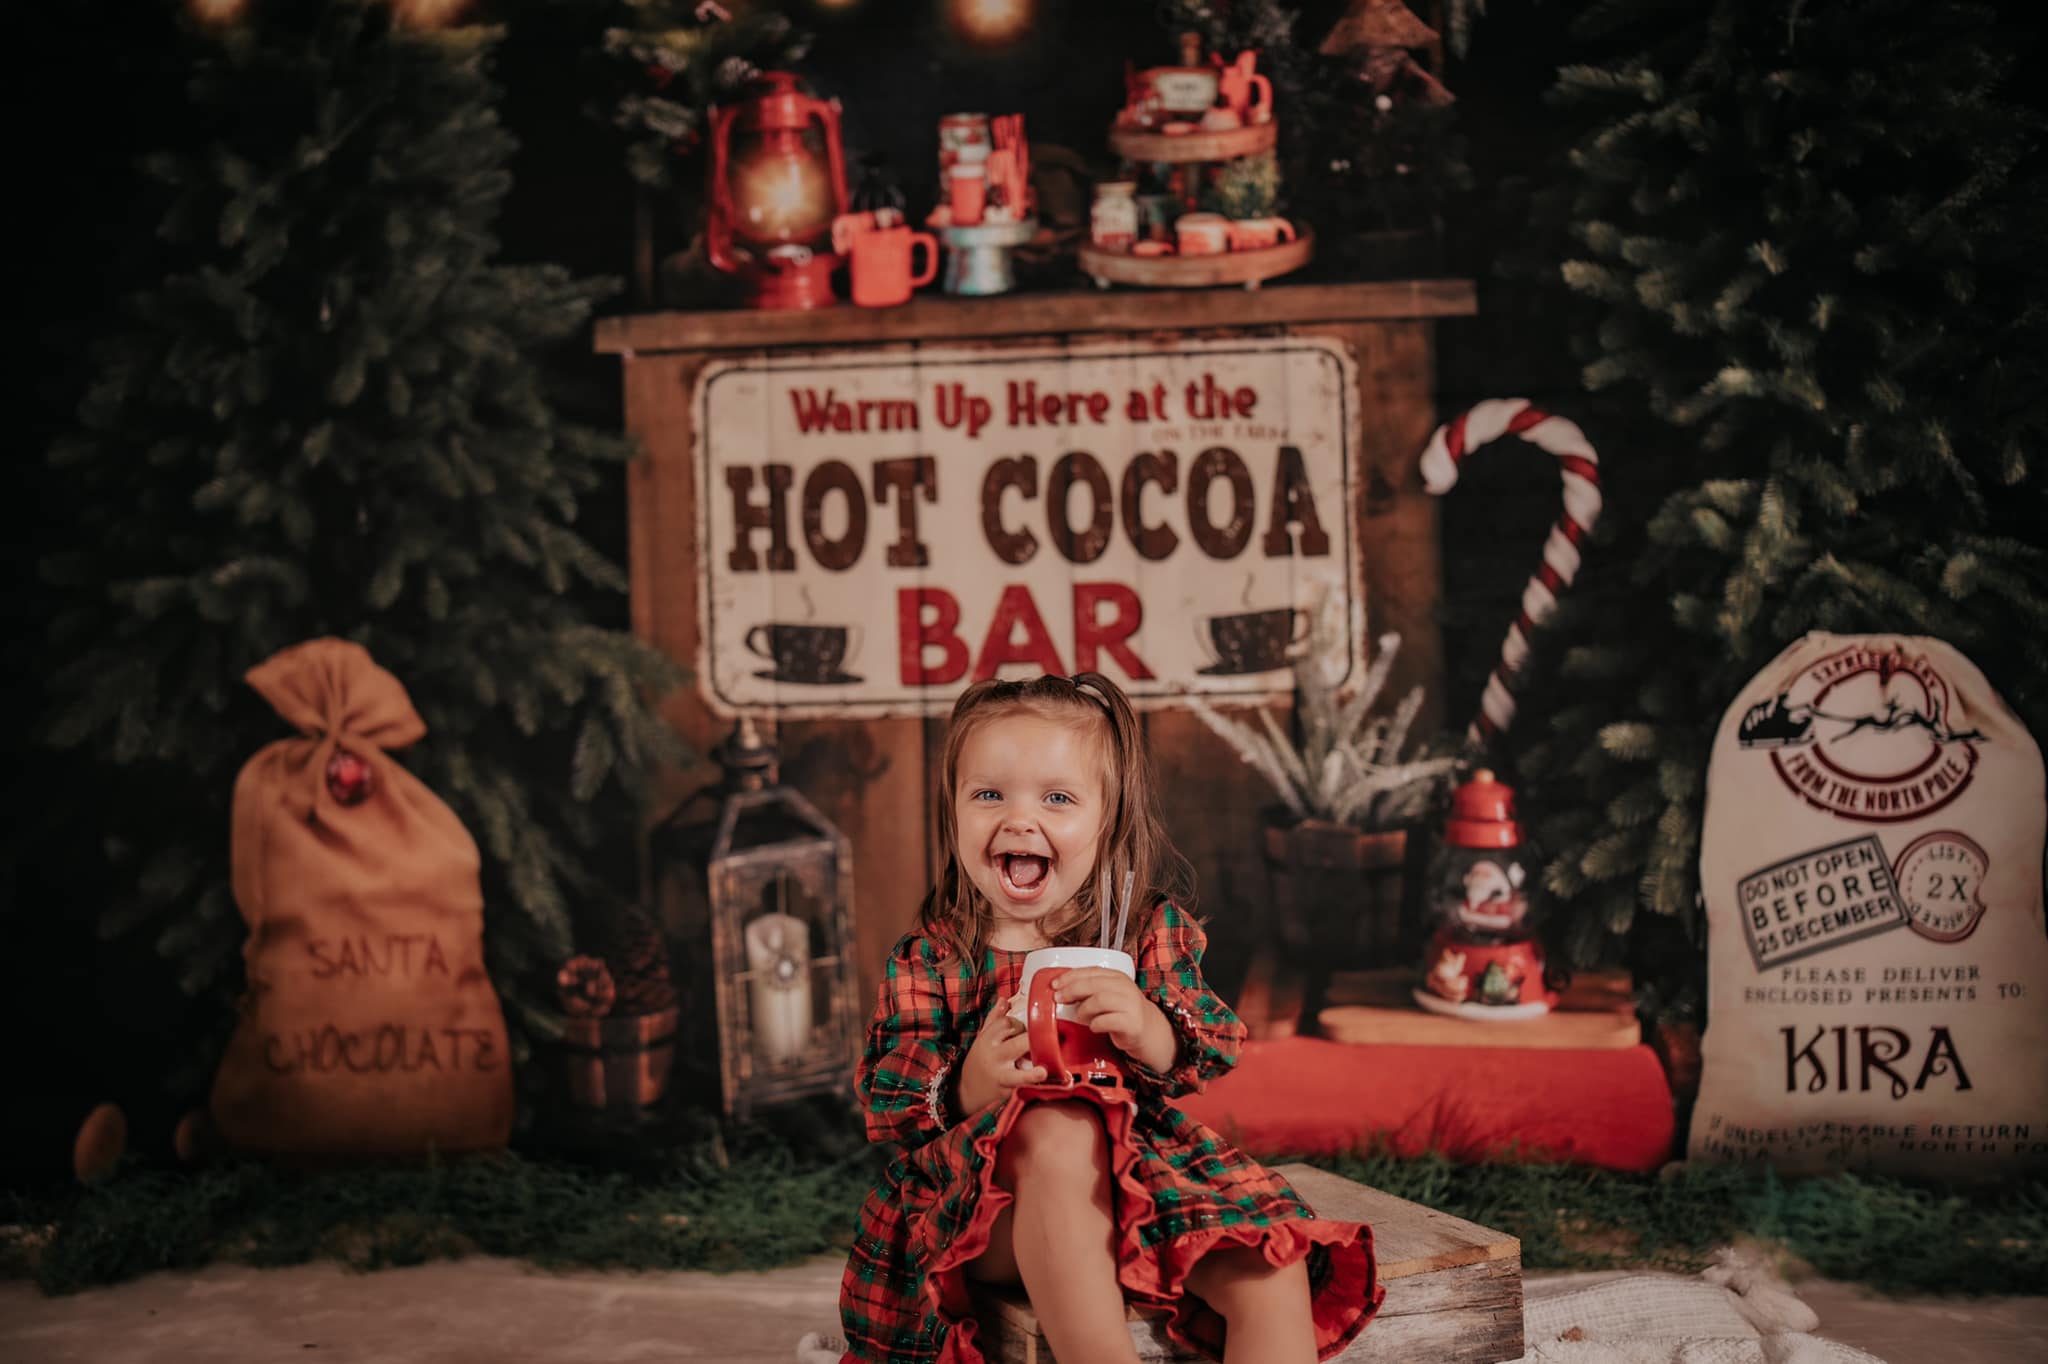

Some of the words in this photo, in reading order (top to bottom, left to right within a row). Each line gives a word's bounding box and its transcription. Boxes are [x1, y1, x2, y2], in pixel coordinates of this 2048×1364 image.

[787, 387, 920, 434] Warm
[935, 382, 992, 438] Up
[1007, 379, 1111, 427] Here
[1125, 380, 1169, 422] at
[1185, 372, 1258, 420] the
[725, 455, 939, 573] HOT
[981, 445, 1331, 566] COCOA
[898, 582, 1158, 686] BAR
[1786, 753, 1829, 794] FROM
[1827, 781, 1858, 808] THE
[1865, 784, 1925, 811] NORTH
[1925, 756, 1965, 801] POLE
[1745, 881, 1768, 902] DO
[1772, 864, 1809, 893] NOT
[1815, 845, 1875, 879] OPEN
[1752, 868, 1888, 930] BEFORE
[1757, 934, 1780, 956] 25
[1783, 898, 1894, 946] DECEMBER
[307, 934, 449, 979] SANTA
[1782, 968, 1867, 984] PLEASE
[1884, 966, 1980, 983] DELIVER
[1744, 986, 1852, 1005] ENCLOSED
[1866, 985, 1977, 1005] PRESENTS
[1779, 1025, 1973, 1100] KIRA
[1930, 1123, 2030, 1140] RETURN
